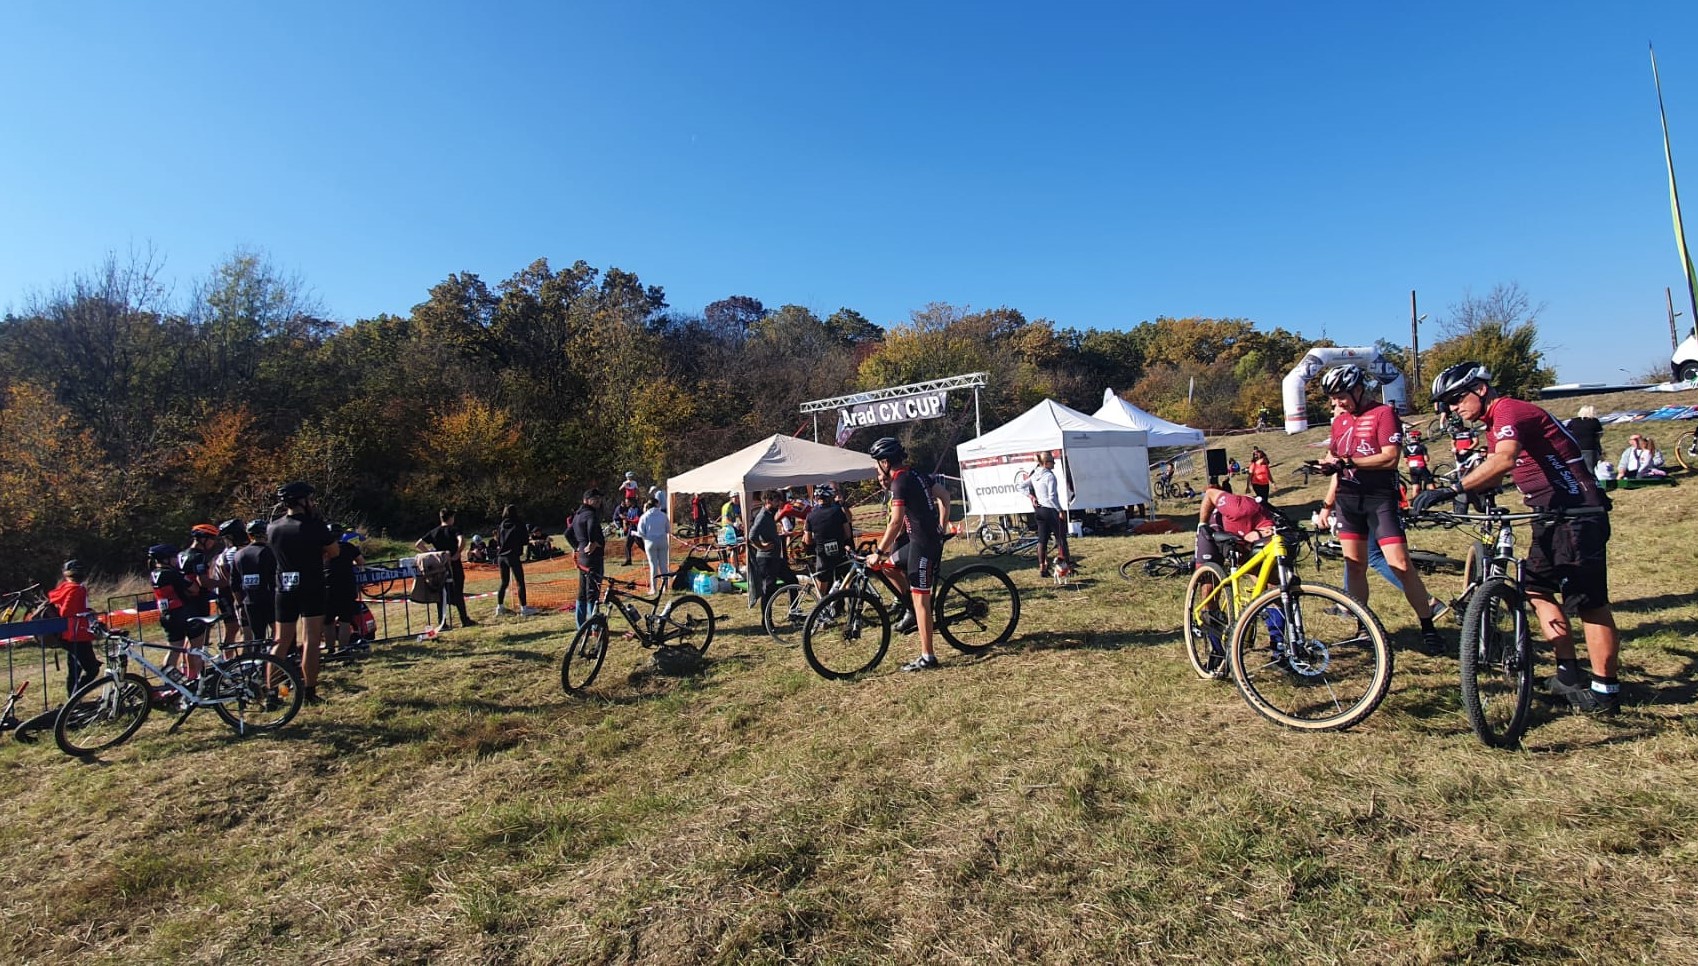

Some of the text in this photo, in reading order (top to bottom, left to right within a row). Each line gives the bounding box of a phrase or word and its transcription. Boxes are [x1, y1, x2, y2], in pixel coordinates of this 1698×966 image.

[842, 396, 940, 427] Arad CX CUP
